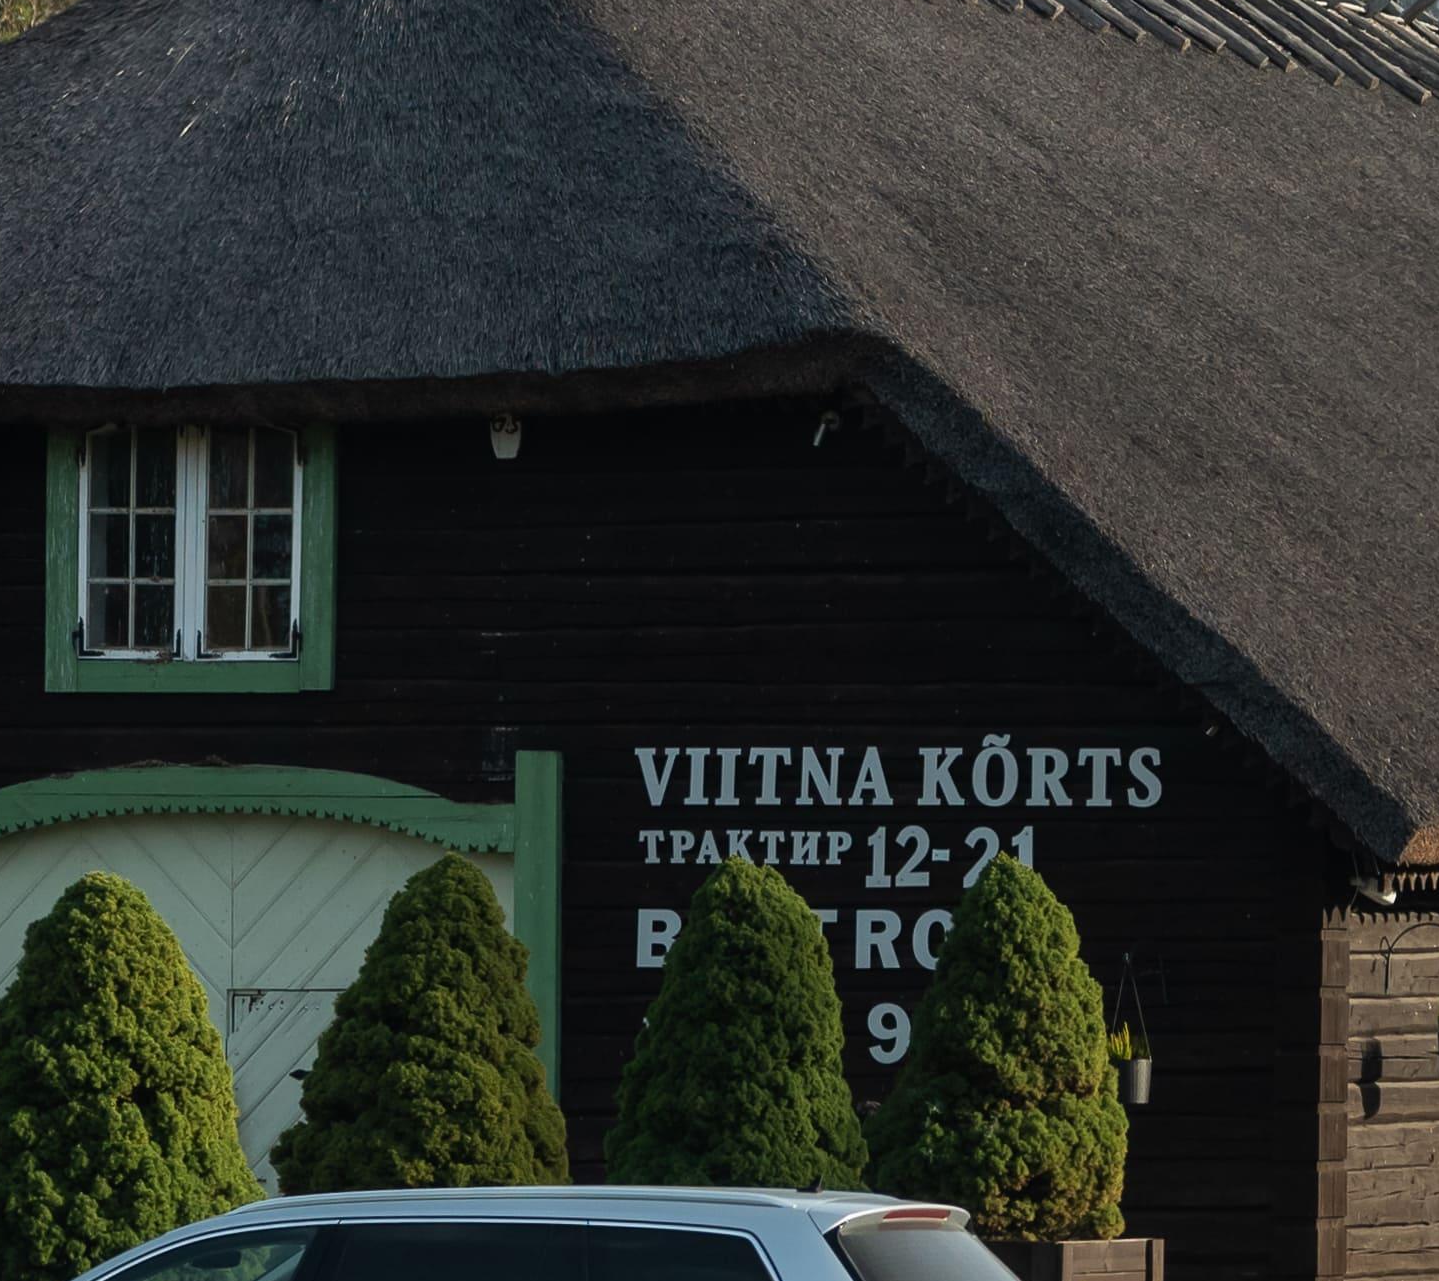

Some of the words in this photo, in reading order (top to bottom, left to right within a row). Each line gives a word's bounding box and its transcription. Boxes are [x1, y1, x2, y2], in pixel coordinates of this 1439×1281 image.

[635, 746, 894, 806] VIITNA
[917, 734, 1162, 808] KÕRTS
[638, 829, 852, 866] ТРАКТИР
[636, 908, 955, 970] BRO
